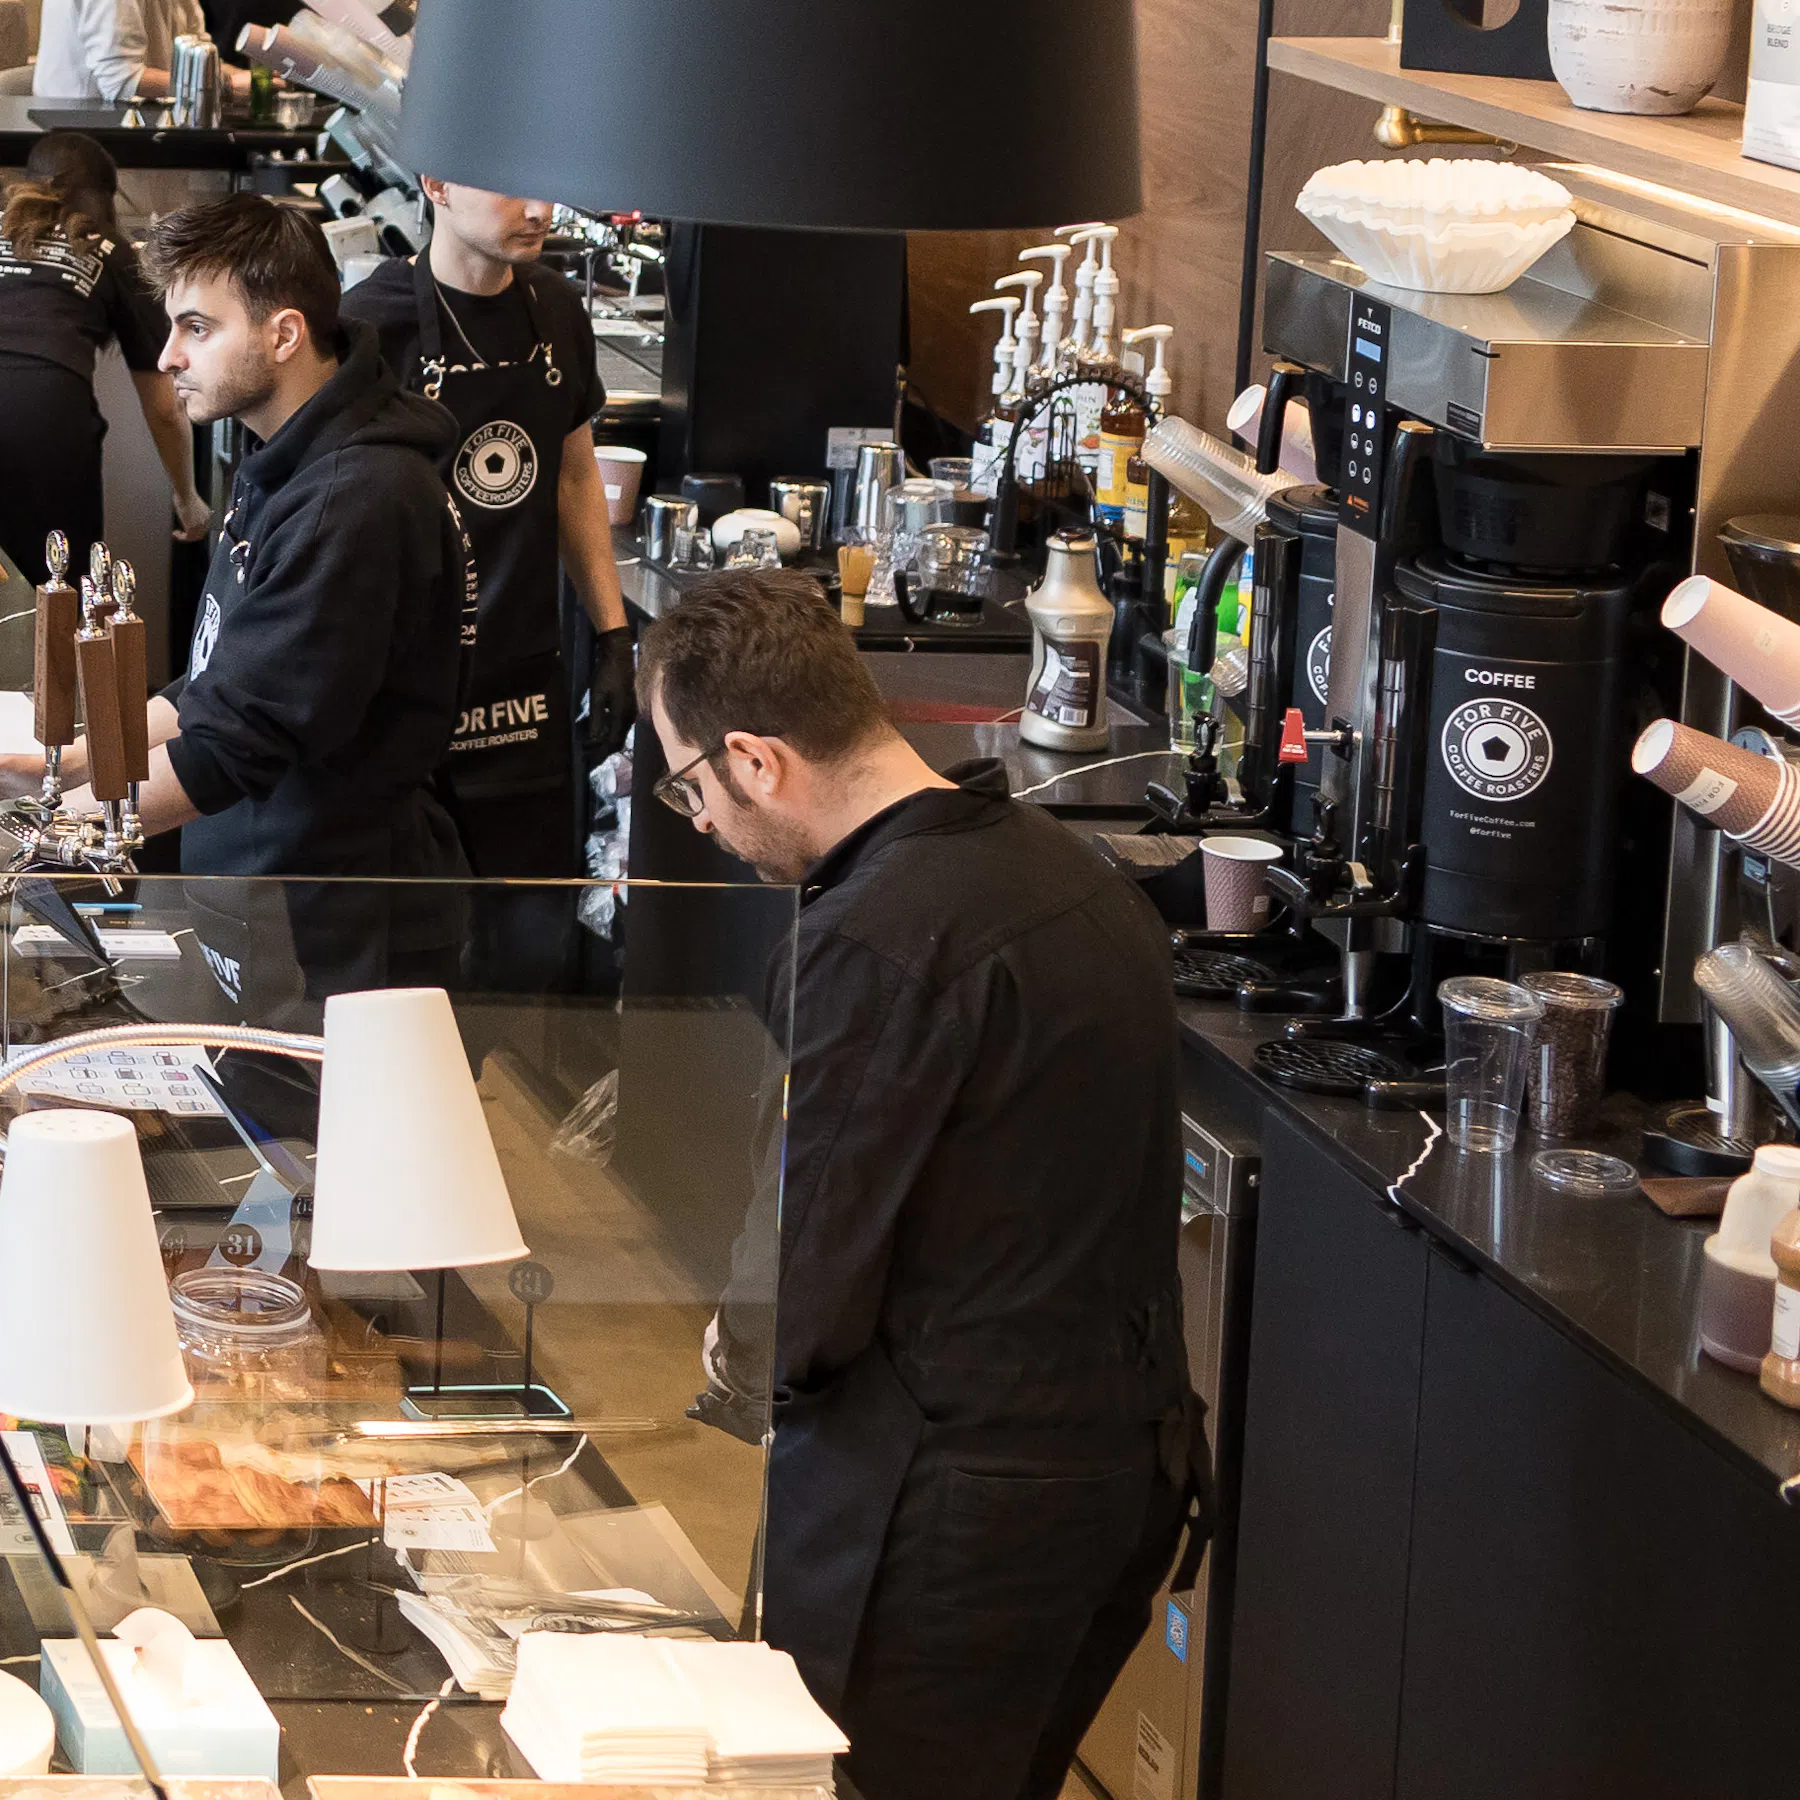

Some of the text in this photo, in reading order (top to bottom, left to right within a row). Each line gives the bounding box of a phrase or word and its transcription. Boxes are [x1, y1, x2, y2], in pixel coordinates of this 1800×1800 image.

[465, 424, 529, 455] FOR FIVE
[1464, 669, 1536, 689] COFFEE
[491, 694, 549, 729] FIVE
[1453, 704, 1543, 741] FOR FIVE
[487, 728, 538, 746] ROASTERS
[1448, 744, 1546, 795] COFFEE ROASTERS
[226, 1233, 255, 1257] 31
